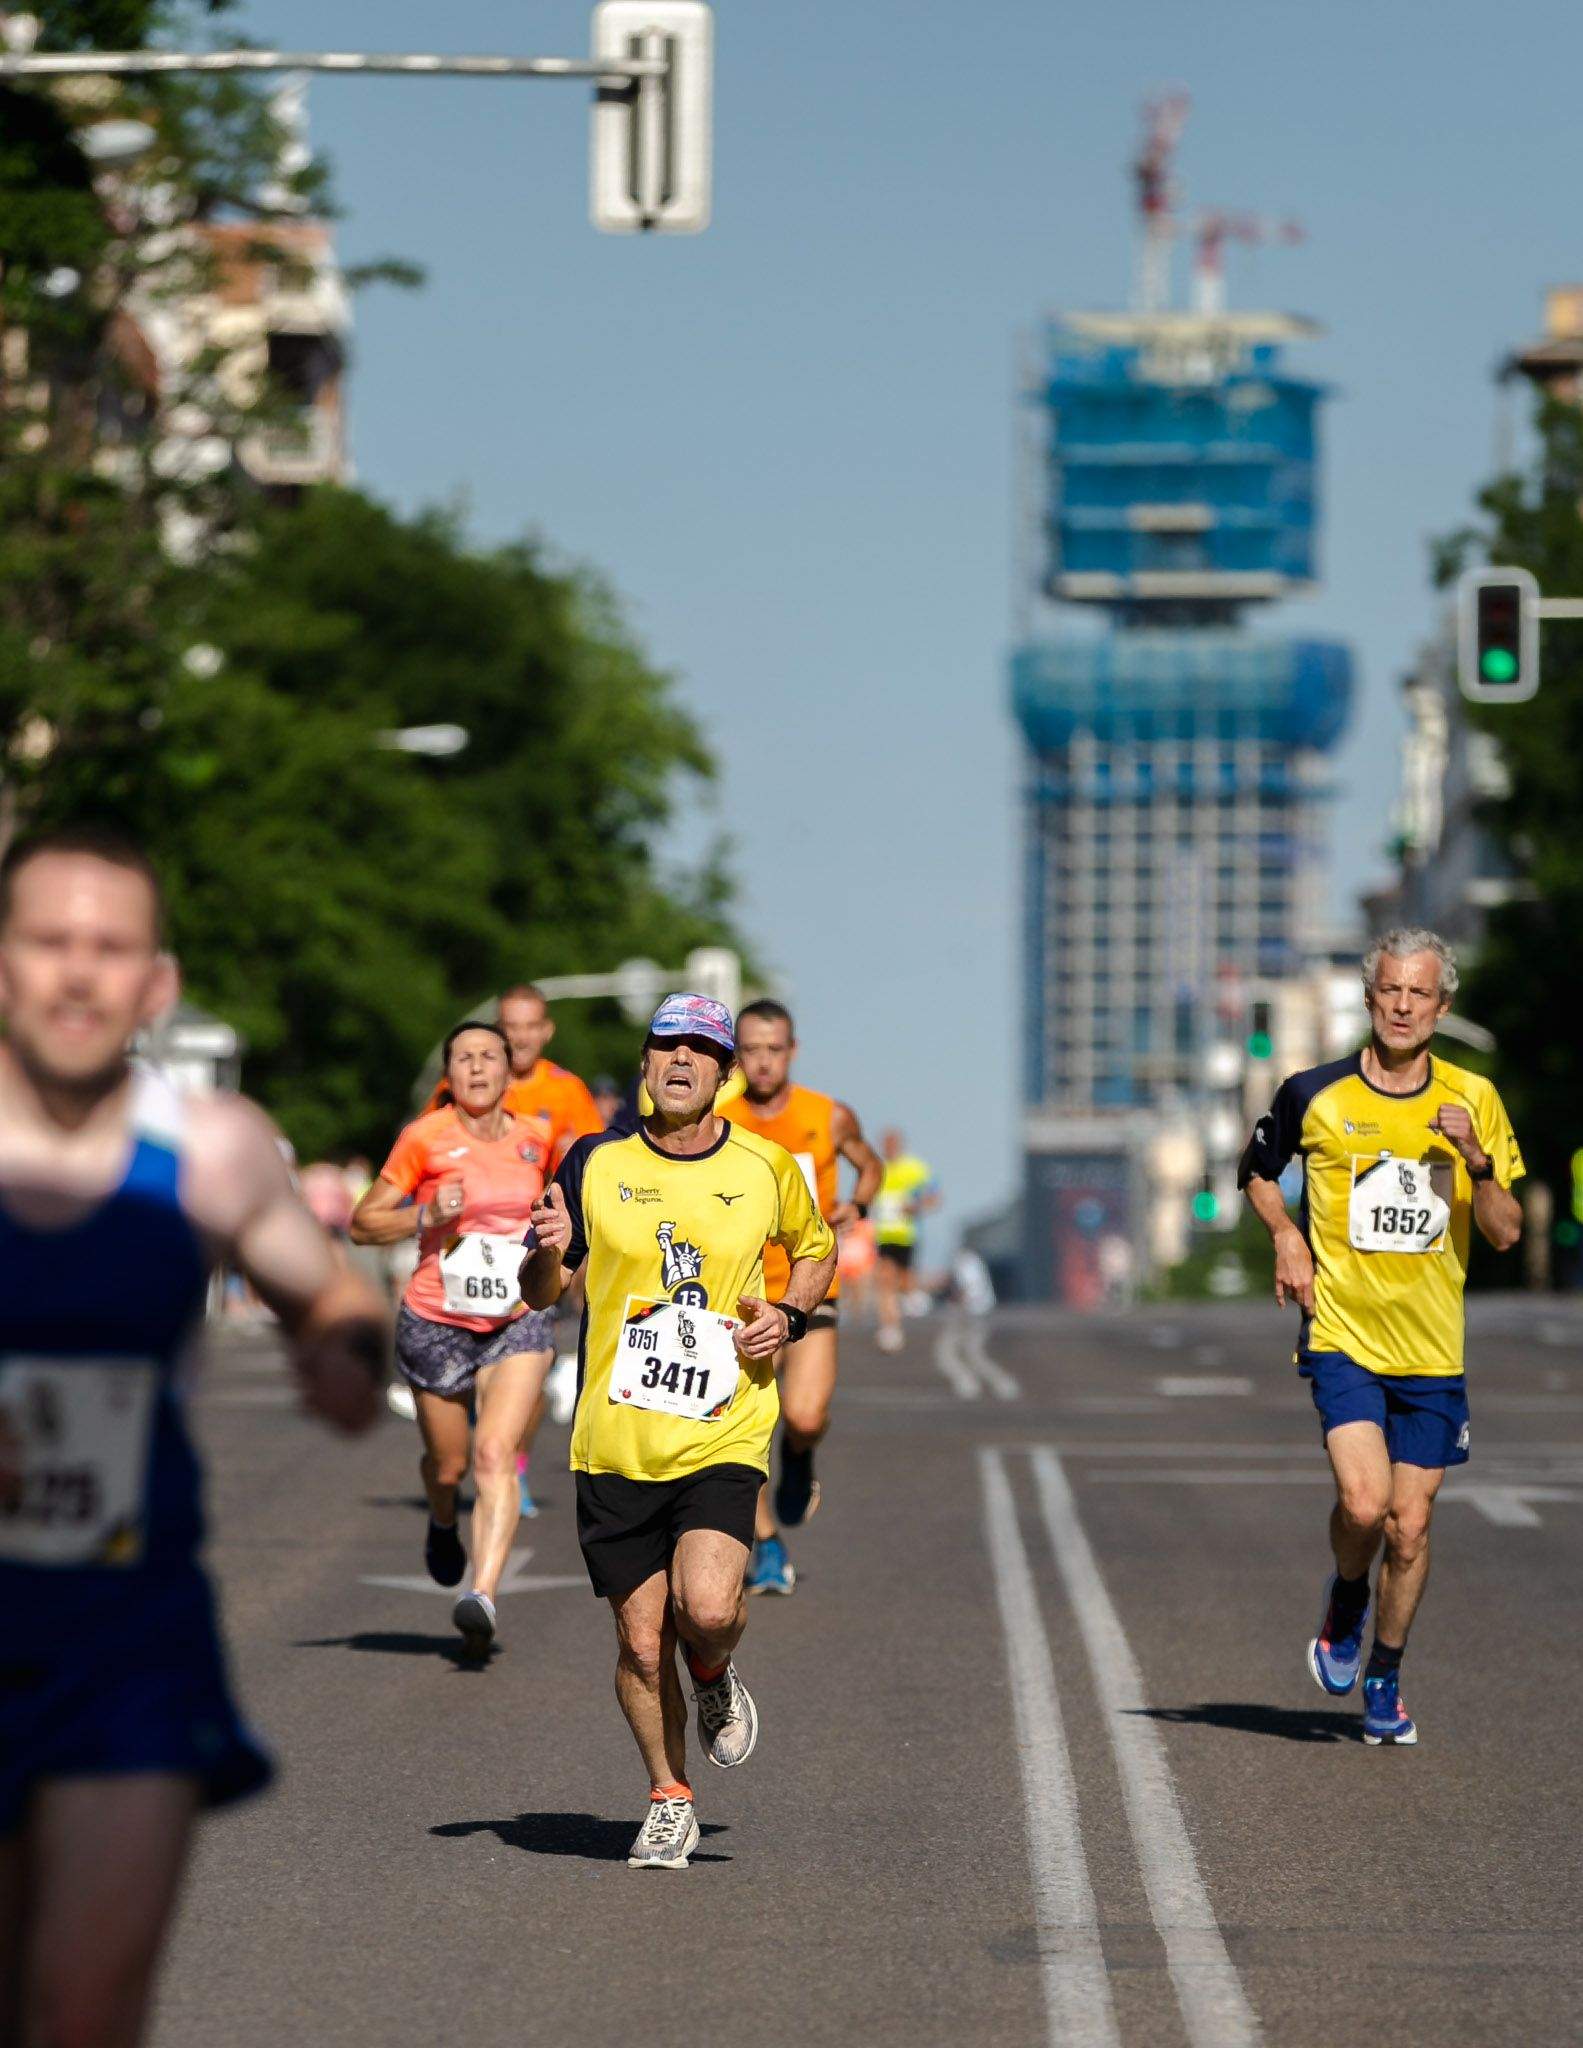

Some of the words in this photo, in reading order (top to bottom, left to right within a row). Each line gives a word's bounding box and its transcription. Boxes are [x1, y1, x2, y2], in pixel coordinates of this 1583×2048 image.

[635, 1187, 660, 1196] Liberty
[1371, 1206, 1431, 1235] 1352
[466, 1276, 508, 1299] 685
[680, 1290, 701, 1308] 13
[628, 1327, 659, 1351] 8751
[641, 1356, 711, 1399] 3411
